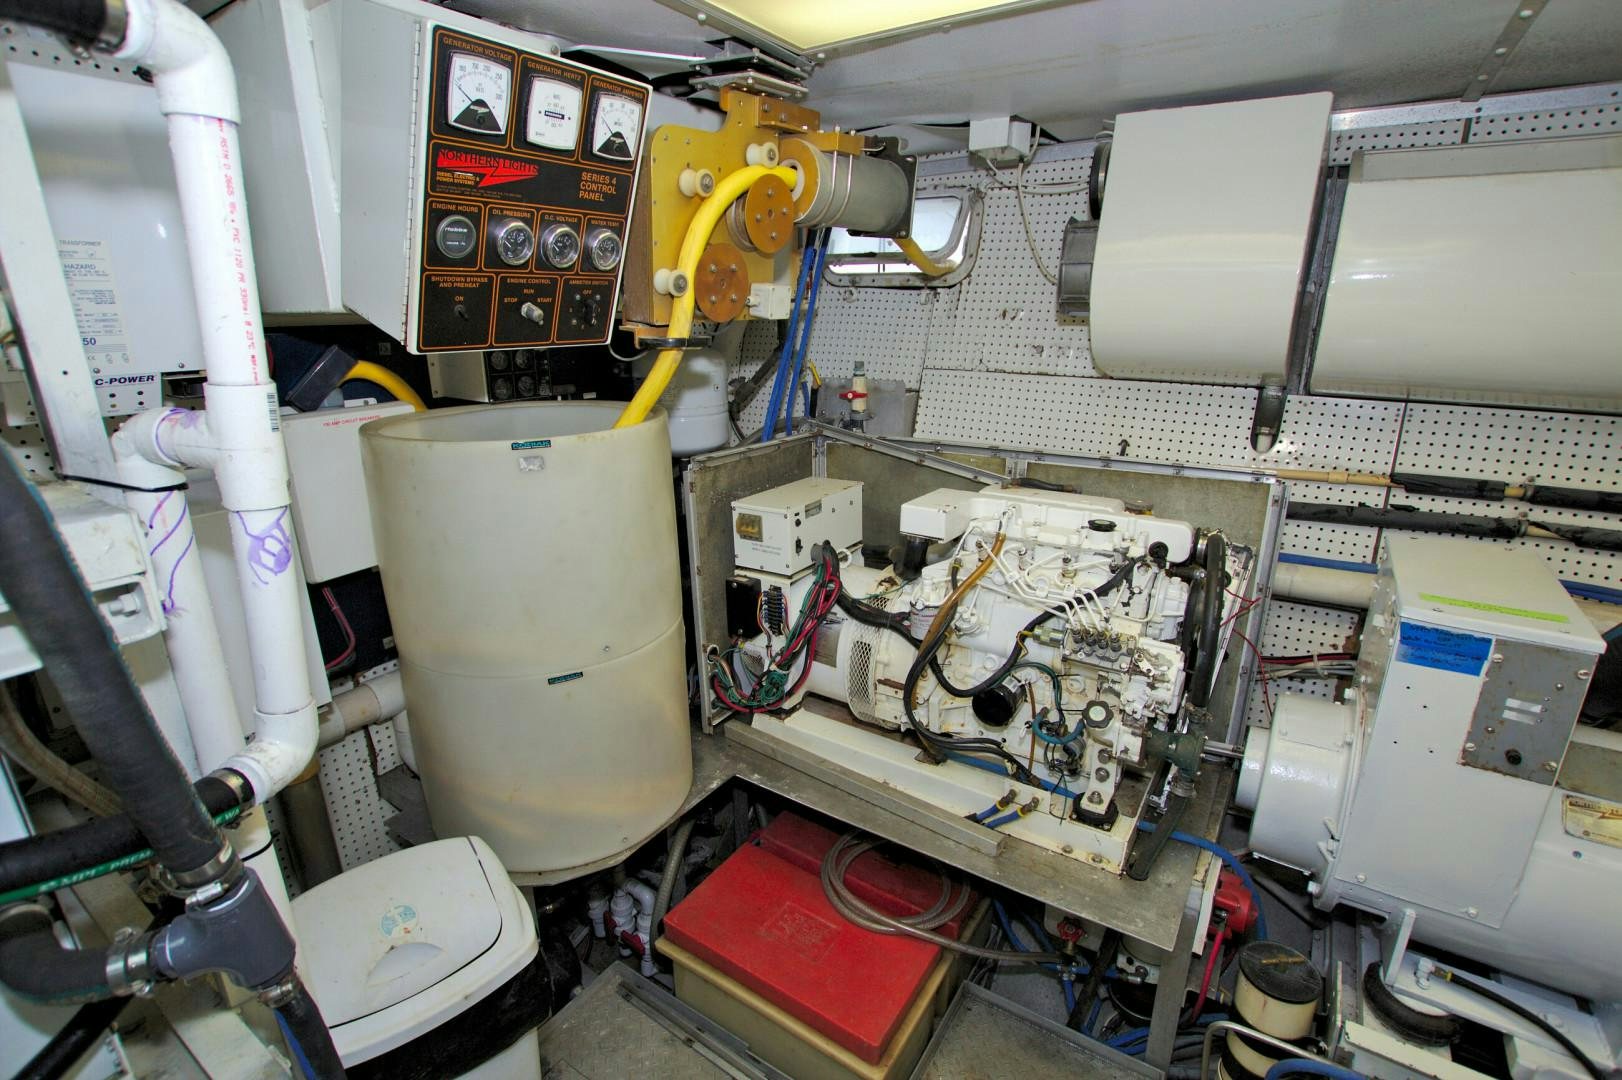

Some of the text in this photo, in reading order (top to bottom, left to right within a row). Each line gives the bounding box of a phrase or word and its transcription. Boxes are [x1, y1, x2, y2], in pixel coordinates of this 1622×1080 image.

[443, 36, 512, 61] GENERATOR VOLTAGE
[528, 61, 581, 80] GENERATOR HERTZ
[593, 80, 622, 93] GENERATOR
[440, 149, 539, 173] NORTHERN LIGHTS
[581, 171, 617, 185] SERIES 4
[580, 181, 617, 194] CONTROL
[579, 190, 605, 202] PANEL
[432, 202, 479, 213] ENGINE HOURS
[503, 210, 531, 218] PRESSURE
[431, 275, 465, 283] SHUTDOWN
[94, 374, 155, 386] C-POWER
